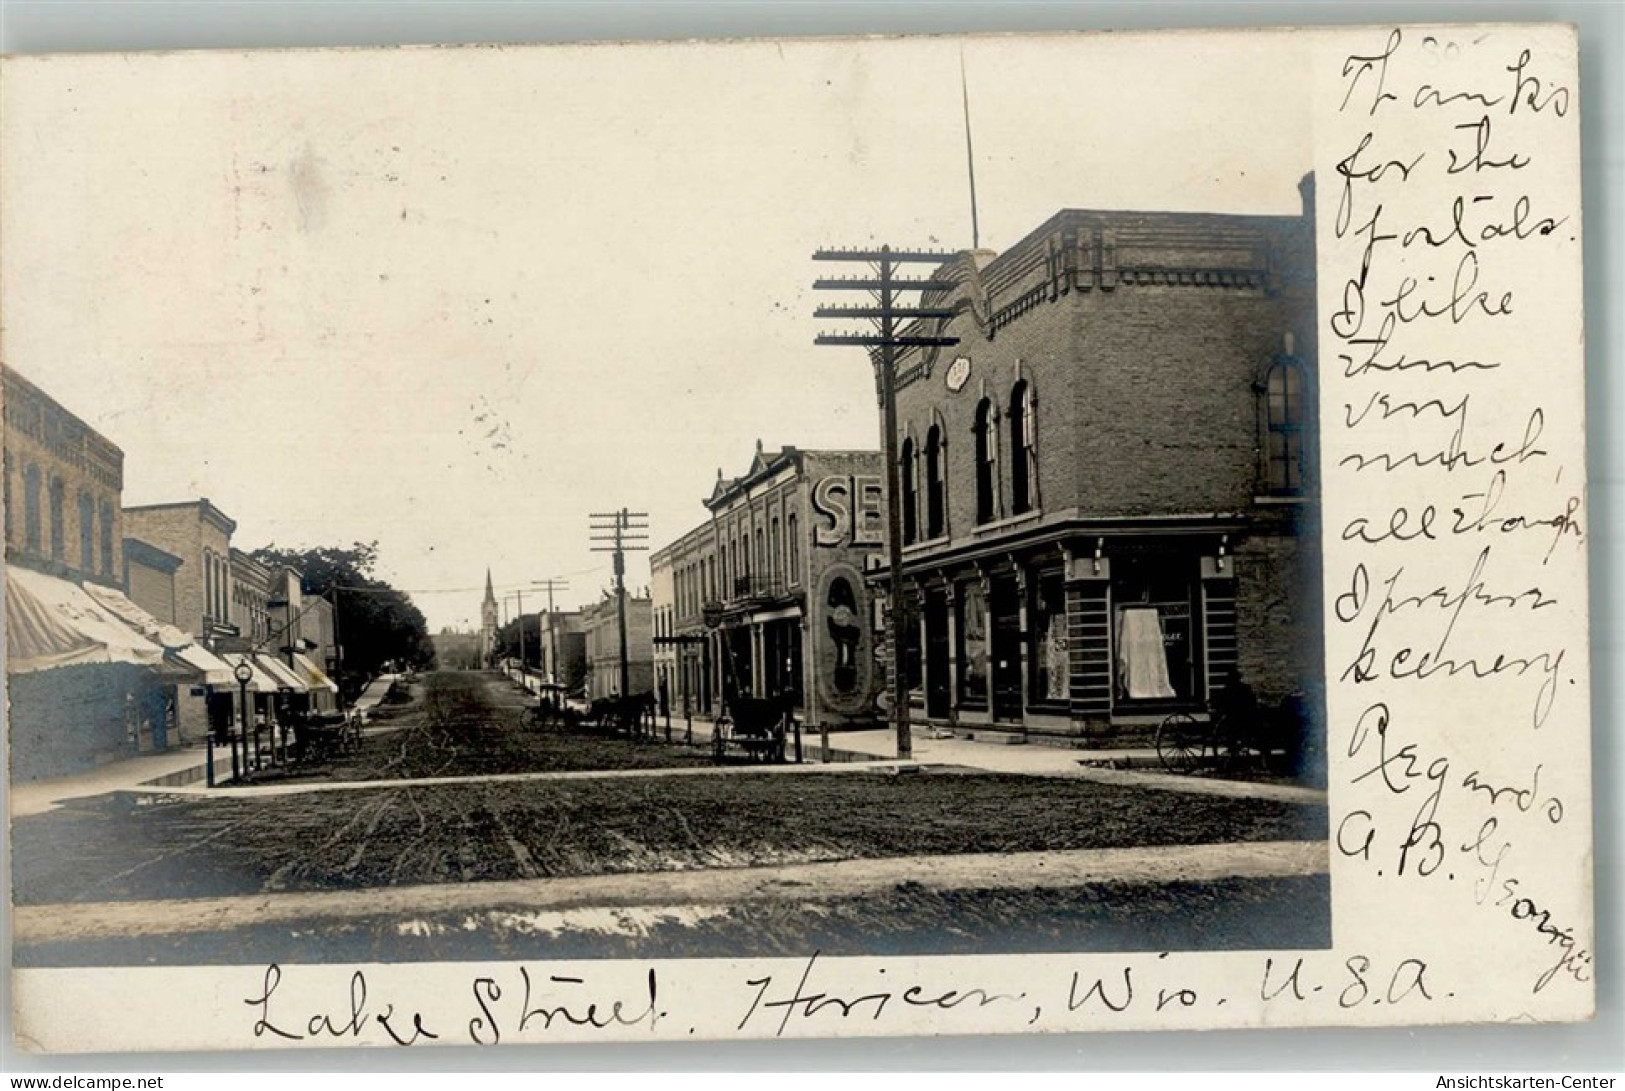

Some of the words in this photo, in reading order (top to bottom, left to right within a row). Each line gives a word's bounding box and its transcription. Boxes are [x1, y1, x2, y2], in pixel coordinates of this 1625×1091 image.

[1341, 28, 1570, 118] Thanks
[1336, 132, 1425, 238] for
[1447, 115, 1531, 175] the
[1331, 279, 1364, 338] I
[1380, 250, 1514, 324] like
[1338, 311, 1500, 378] them
[1345, 391, 1470, 470] very
[1334, 562, 1370, 623] I
[1347, 703, 1563, 842] Regards
[244, 963, 438, 1046] Lake
